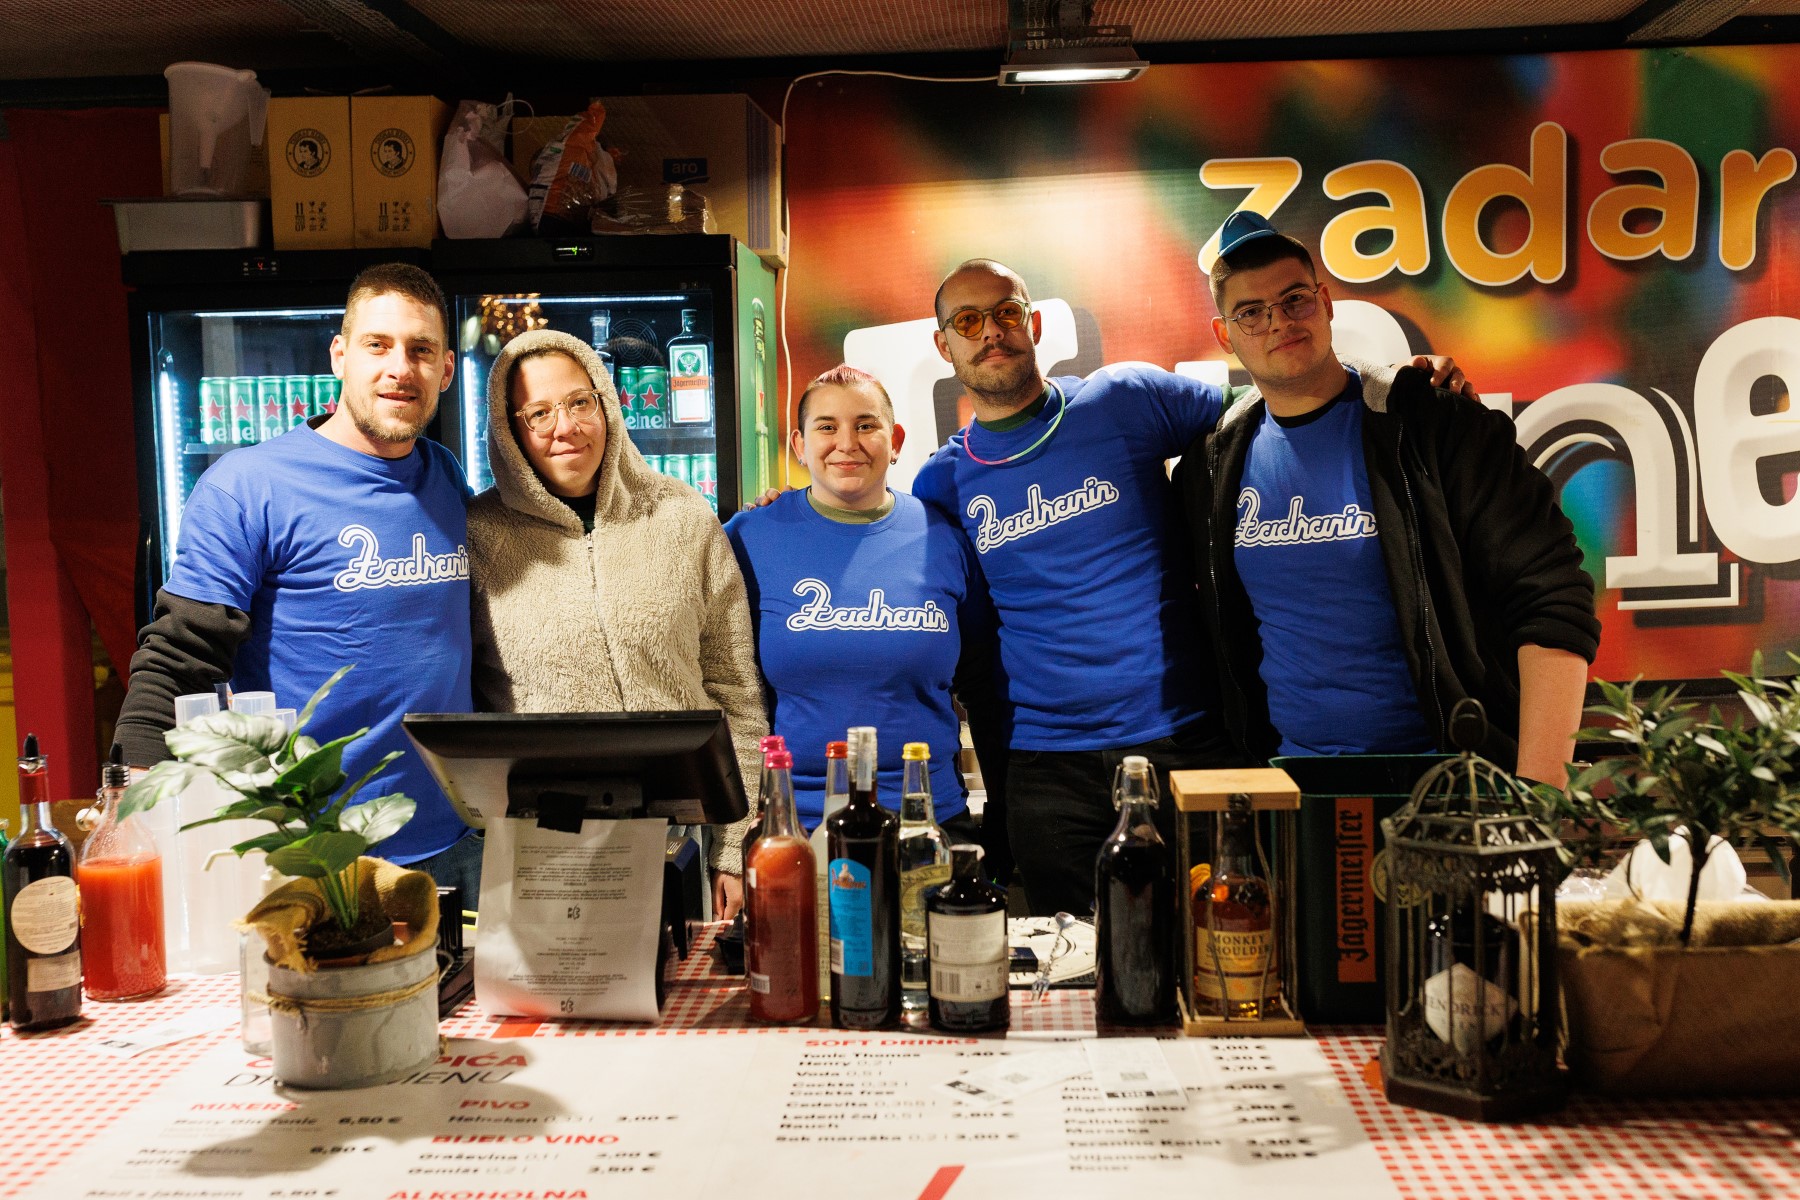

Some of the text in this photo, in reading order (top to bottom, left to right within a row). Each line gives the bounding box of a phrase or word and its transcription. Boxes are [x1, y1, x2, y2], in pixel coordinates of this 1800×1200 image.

[671, 162, 699, 174] aro
[1198, 121, 1798, 287] zadar
[966, 476, 1120, 555] Zadranin
[1234, 486, 1379, 548] Zadranin
[786, 577, 949, 633] Zadranin
[804, 1038, 980, 1047] SOFT DRINKS
[189, 1101, 300, 1111] MIXERS
[458, 1099, 531, 1110] PIVO
[430, 1135, 621, 1145] BIJELO VINO
[386, 1189, 590, 1200] ALKOHOLNA
